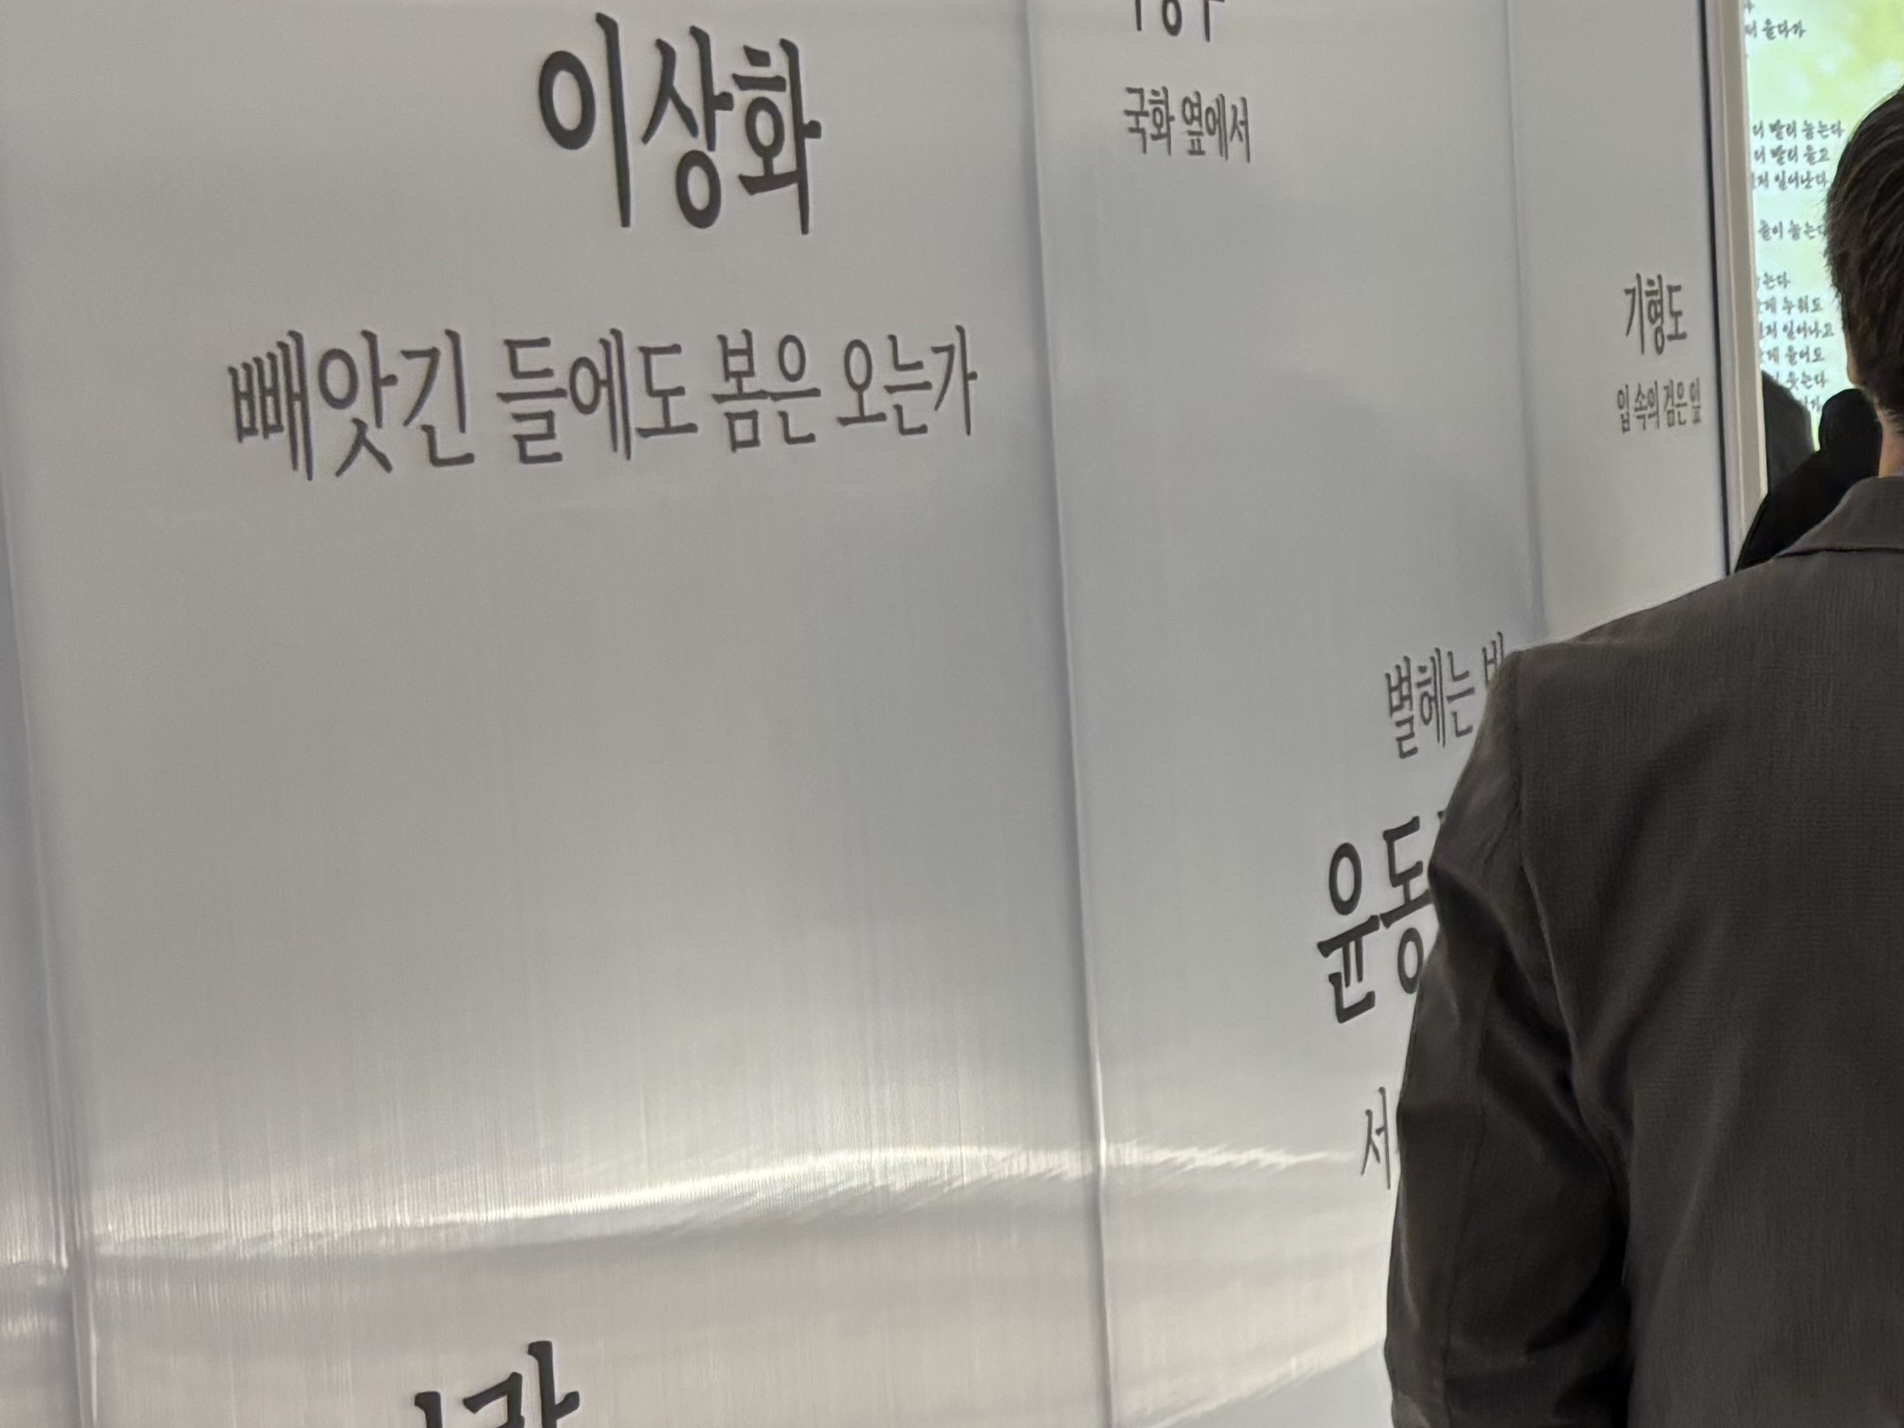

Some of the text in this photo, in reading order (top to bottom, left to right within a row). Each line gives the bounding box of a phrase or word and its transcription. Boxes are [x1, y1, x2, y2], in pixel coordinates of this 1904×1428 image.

[539, 12, 822, 235] 이상화
[1123, 85, 1251, 163] 국화 옆에서
[1623, 273, 1688, 356] 기형도
[227, 325, 978, 480] 빼앗긴 들에도 봄은 오는가
[1616, 383, 1631, 434] 입
[1634, 380, 1660, 431] 속의
[1663, 379, 1688, 427] 검은
[1316, 808, 1446, 1023] 윤동
